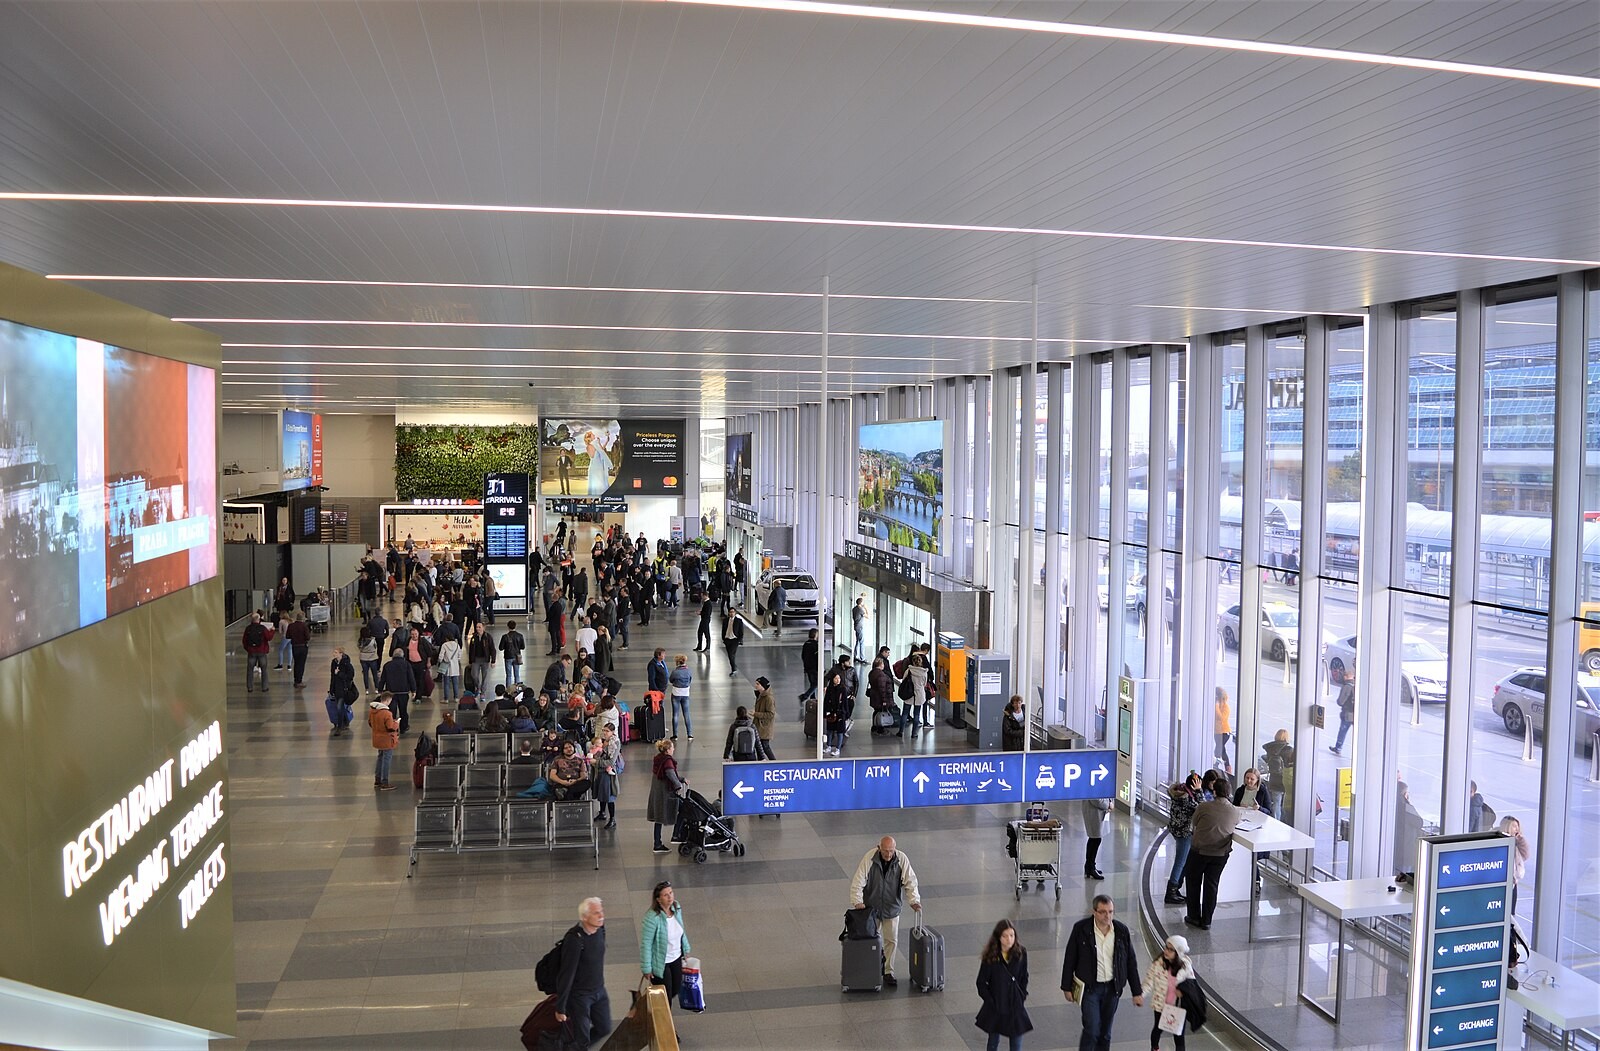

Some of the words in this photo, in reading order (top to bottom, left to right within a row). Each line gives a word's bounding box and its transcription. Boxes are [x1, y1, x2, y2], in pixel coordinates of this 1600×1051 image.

[454, 516, 472, 524] Hello
[139, 530, 168, 553] PRAHA
[763, 766, 843, 782] RESTAURANT
[865, 765, 890, 779] ATM
[938, 761, 996, 775] TERMINAL
[999, 760, 1004, 773] 1
[1063, 763, 1082, 788] P
[763, 787, 795, 795] RESTAURACE
[938, 780, 962, 788] TERMINÁL
[61, 757, 175, 898] RESTAURANT
[179, 719, 223, 788] PRAHA
[98, 838, 170, 947] VIEWING
[169, 780, 225, 868] TERRACE
[1459, 860, 1504, 873] RESTAURANT
[177, 841, 227, 930] TOILETS
[1486, 900, 1502, 911] ATM
[1453, 940, 1500, 954] INFORMATION
[1481, 979, 1497, 989] TAXI
[1458, 1018, 1494, 1031] EXCHANGE
